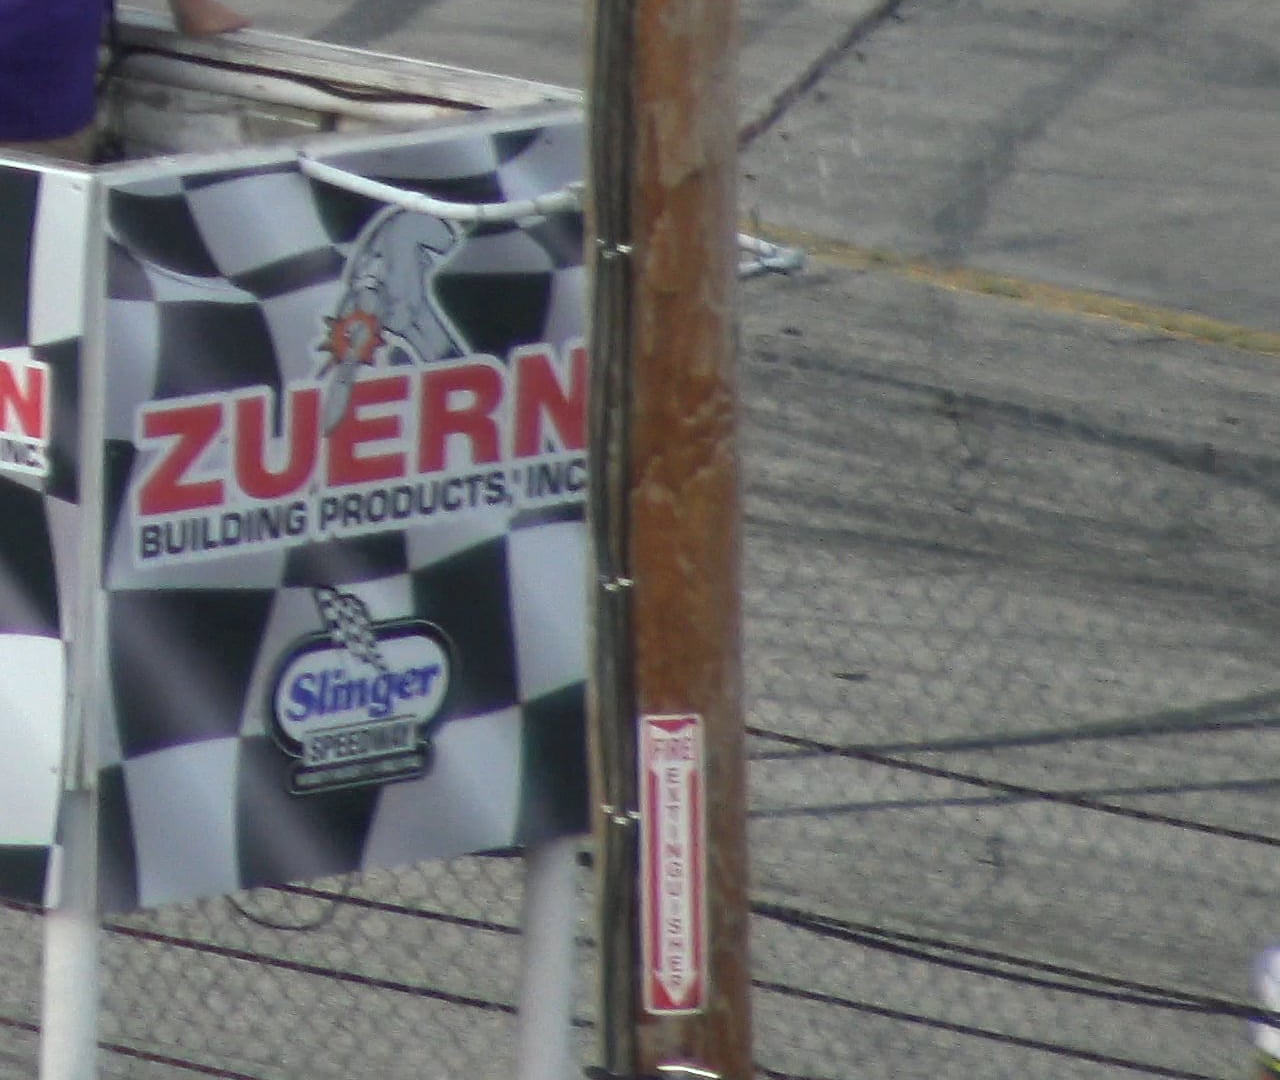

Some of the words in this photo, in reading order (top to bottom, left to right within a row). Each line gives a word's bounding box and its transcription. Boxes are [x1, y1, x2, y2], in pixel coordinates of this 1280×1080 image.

[139, 348, 587, 515] ZUERN
[142, 500, 308, 559] BUILDING
[286, 664, 440, 720] Slinger
